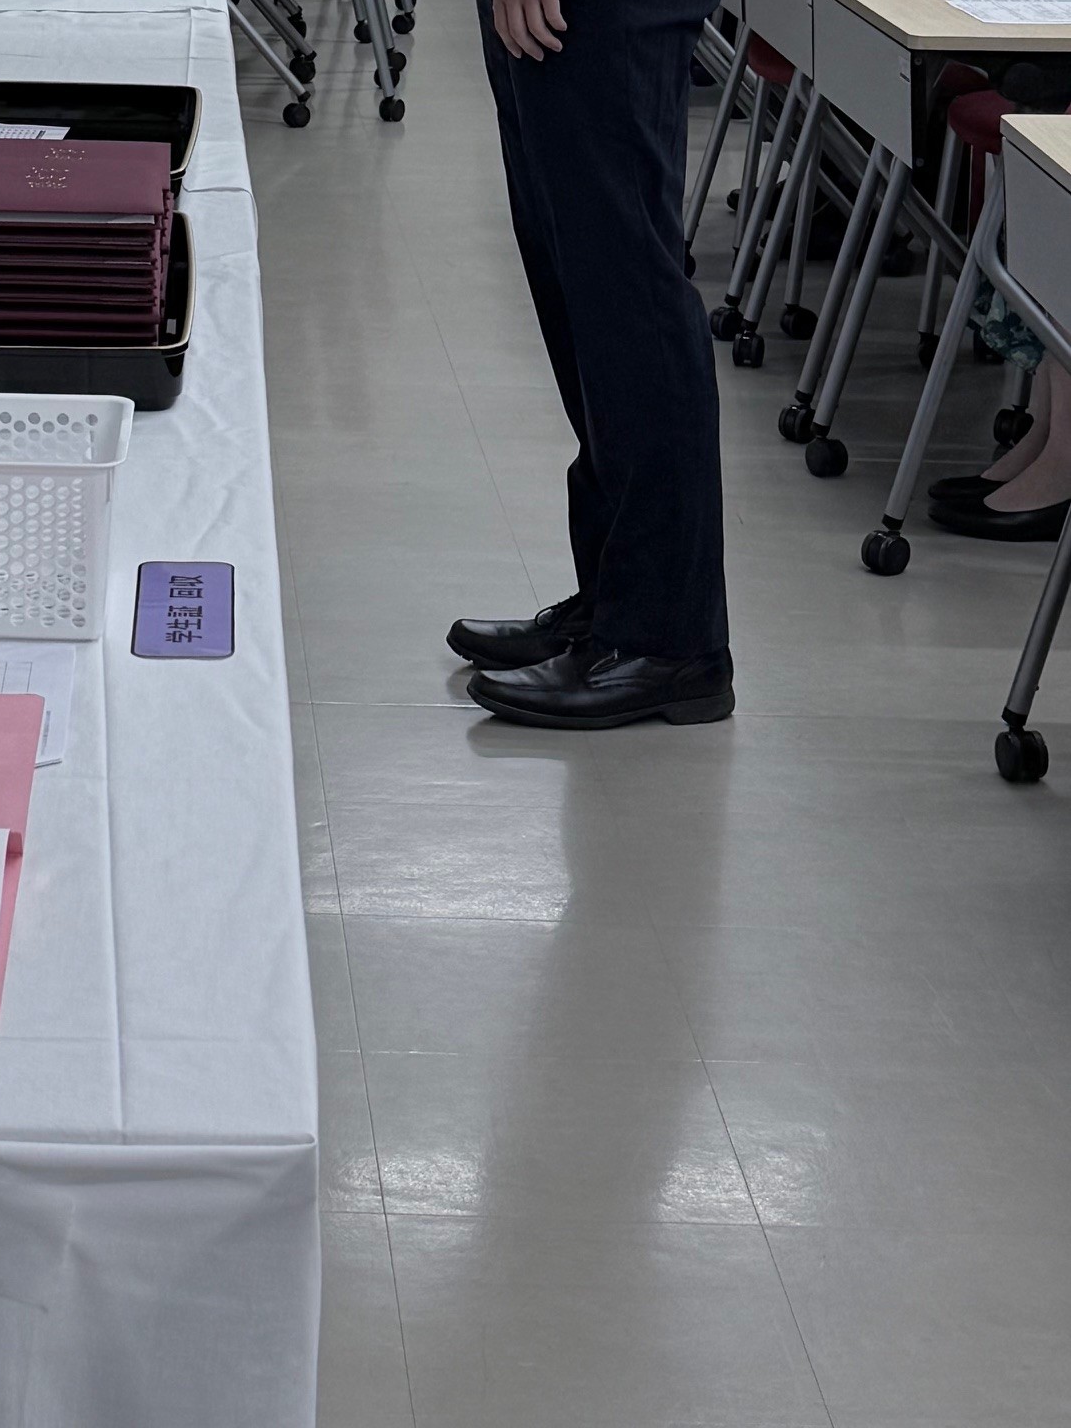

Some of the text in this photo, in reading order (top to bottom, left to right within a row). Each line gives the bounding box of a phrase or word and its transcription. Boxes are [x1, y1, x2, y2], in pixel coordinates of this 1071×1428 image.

[165, 575, 204, 643] 学生証 回収
